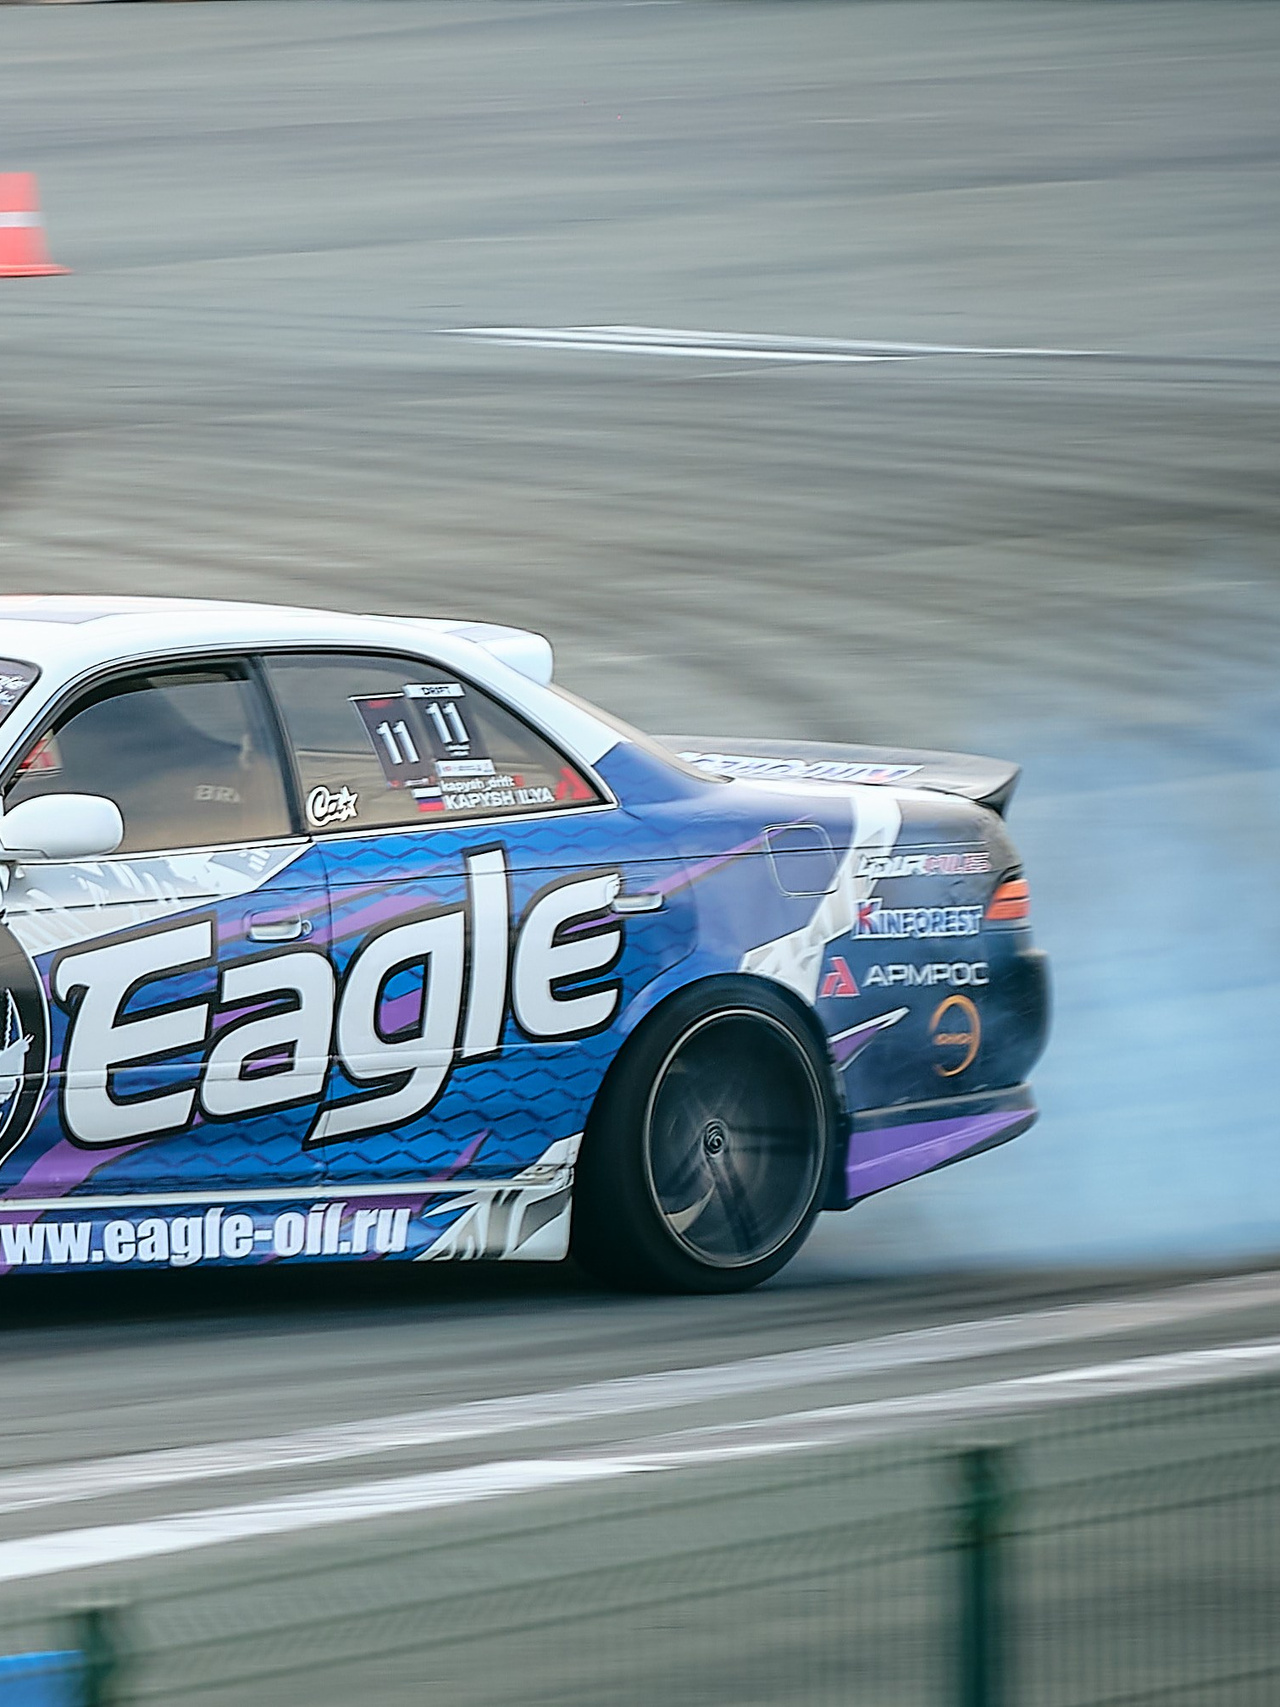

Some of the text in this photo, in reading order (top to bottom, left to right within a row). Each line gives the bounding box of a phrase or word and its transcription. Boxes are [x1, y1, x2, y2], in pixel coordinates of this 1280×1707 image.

[376, 720, 420, 765] 11
[426, 702, 470, 744] 11
[443, 787, 556, 810] KAPYSH ILYA
[52, 841, 627, 1150] Eagle
